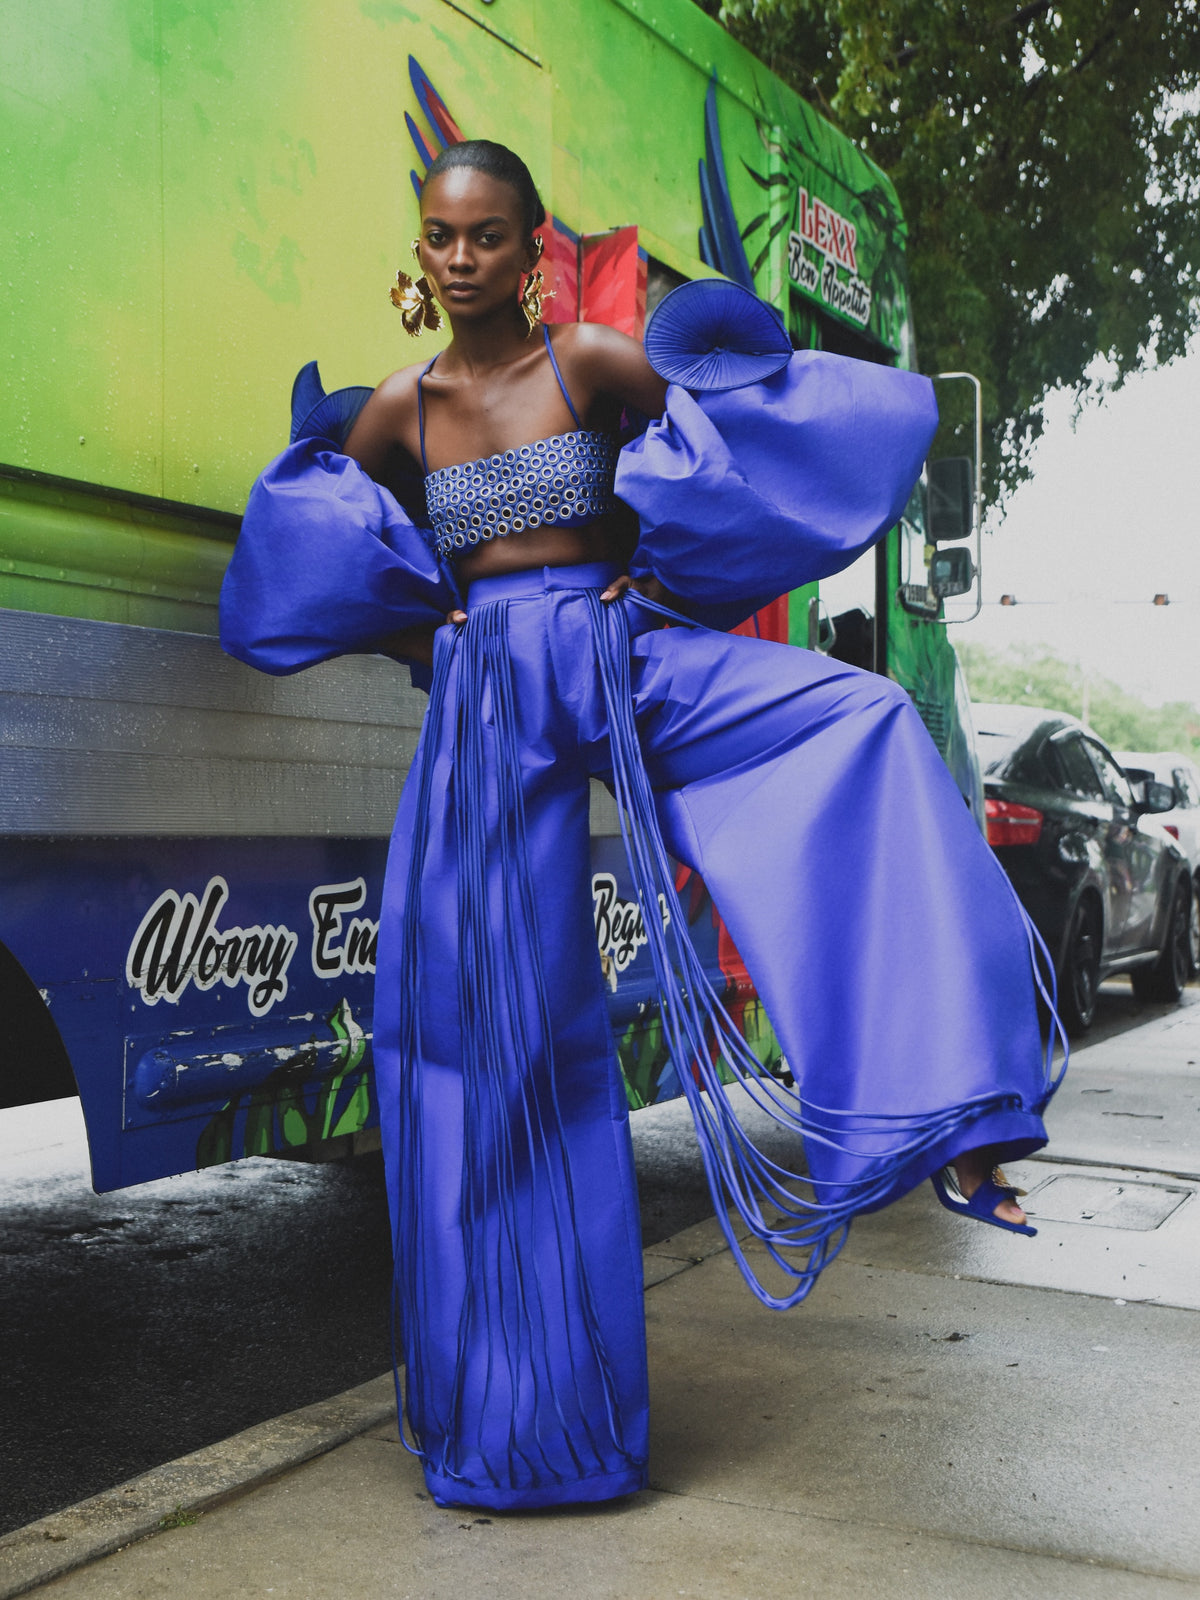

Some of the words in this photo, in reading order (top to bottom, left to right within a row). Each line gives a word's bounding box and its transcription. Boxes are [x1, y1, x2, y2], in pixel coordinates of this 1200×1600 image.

[789, 234, 818, 287] Bon
[800, 191, 857, 271] LEXX
[130, 882, 295, 1010] Worry
